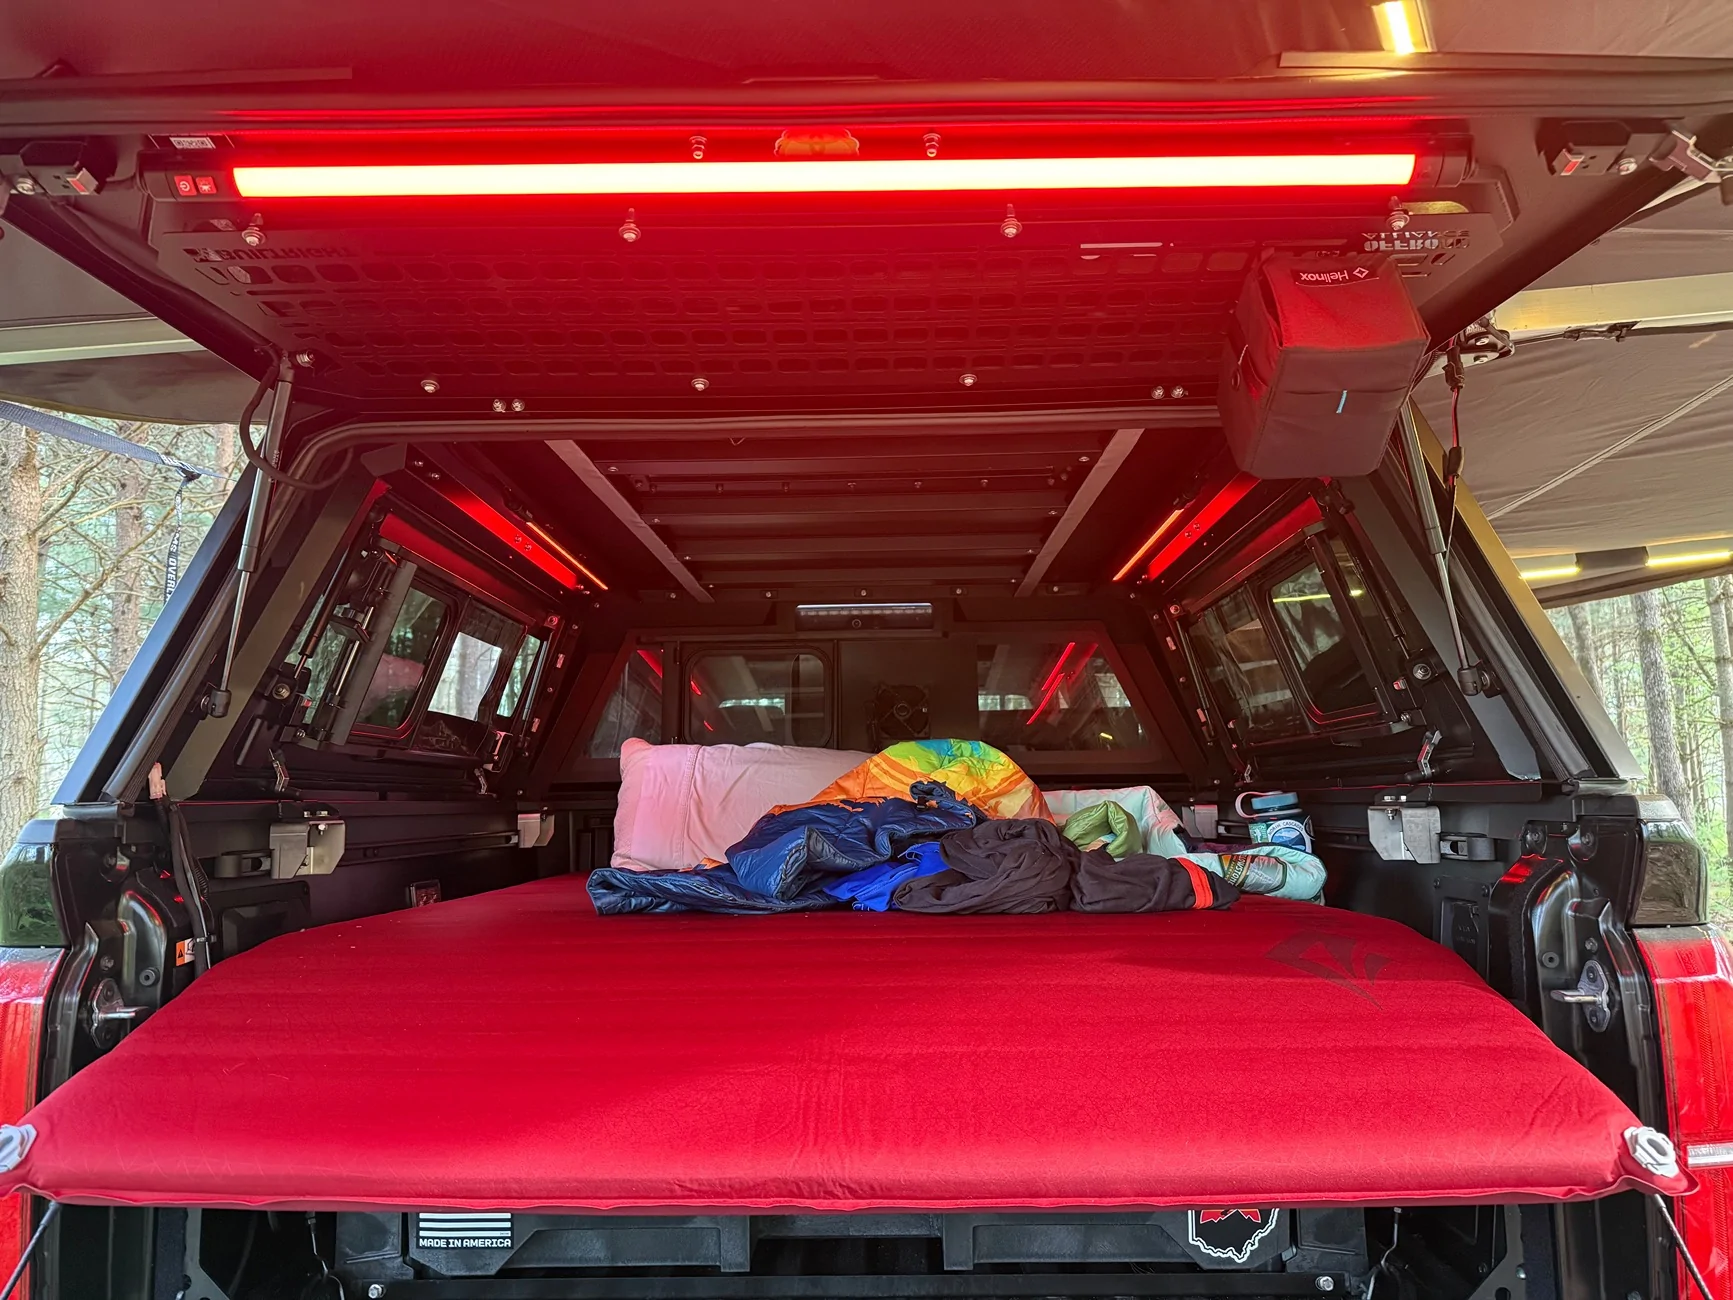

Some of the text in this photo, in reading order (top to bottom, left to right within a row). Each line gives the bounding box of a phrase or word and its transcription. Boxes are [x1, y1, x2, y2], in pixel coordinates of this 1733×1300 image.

[1299, 269, 1349, 283] Helinox
[419, 1238, 511, 1248] MADE IN AMERICA
